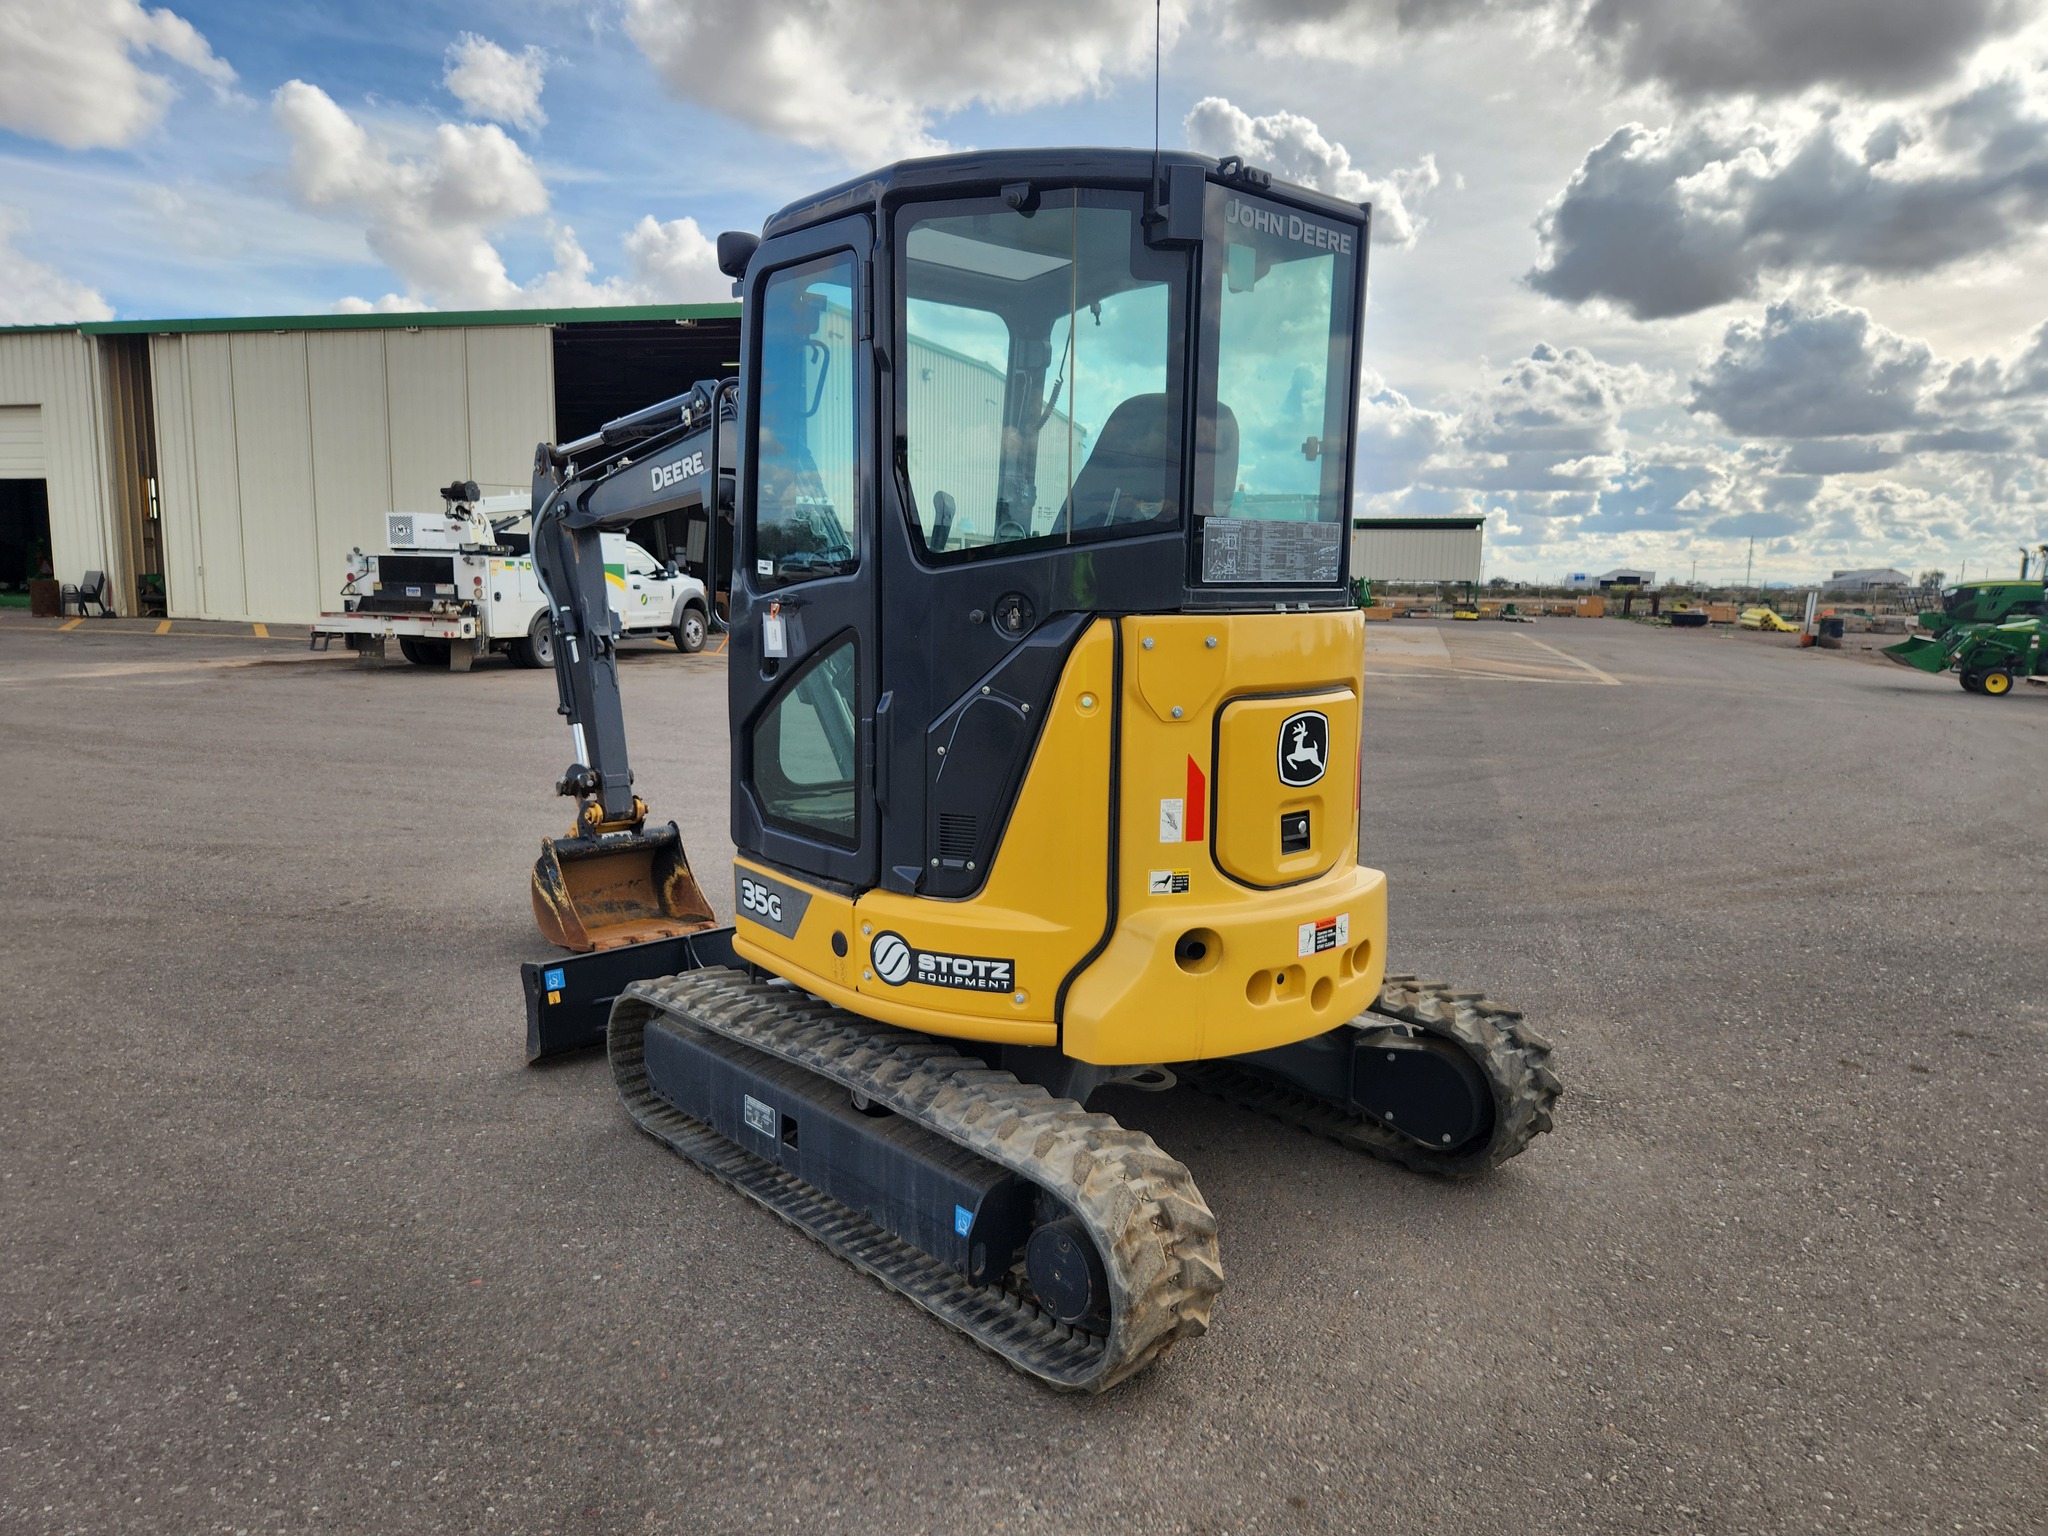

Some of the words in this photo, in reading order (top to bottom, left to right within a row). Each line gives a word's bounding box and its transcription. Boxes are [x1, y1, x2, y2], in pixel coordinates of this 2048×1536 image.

[1226, 198, 1284, 238] JOHN
[1289, 214, 1352, 256] DEERE
[650, 450, 705, 493] DEERE
[741, 879, 783, 922] 35G
[918, 953, 1010, 979] STOTZ
[918, 971, 1010, 990] EQUIPMENT
